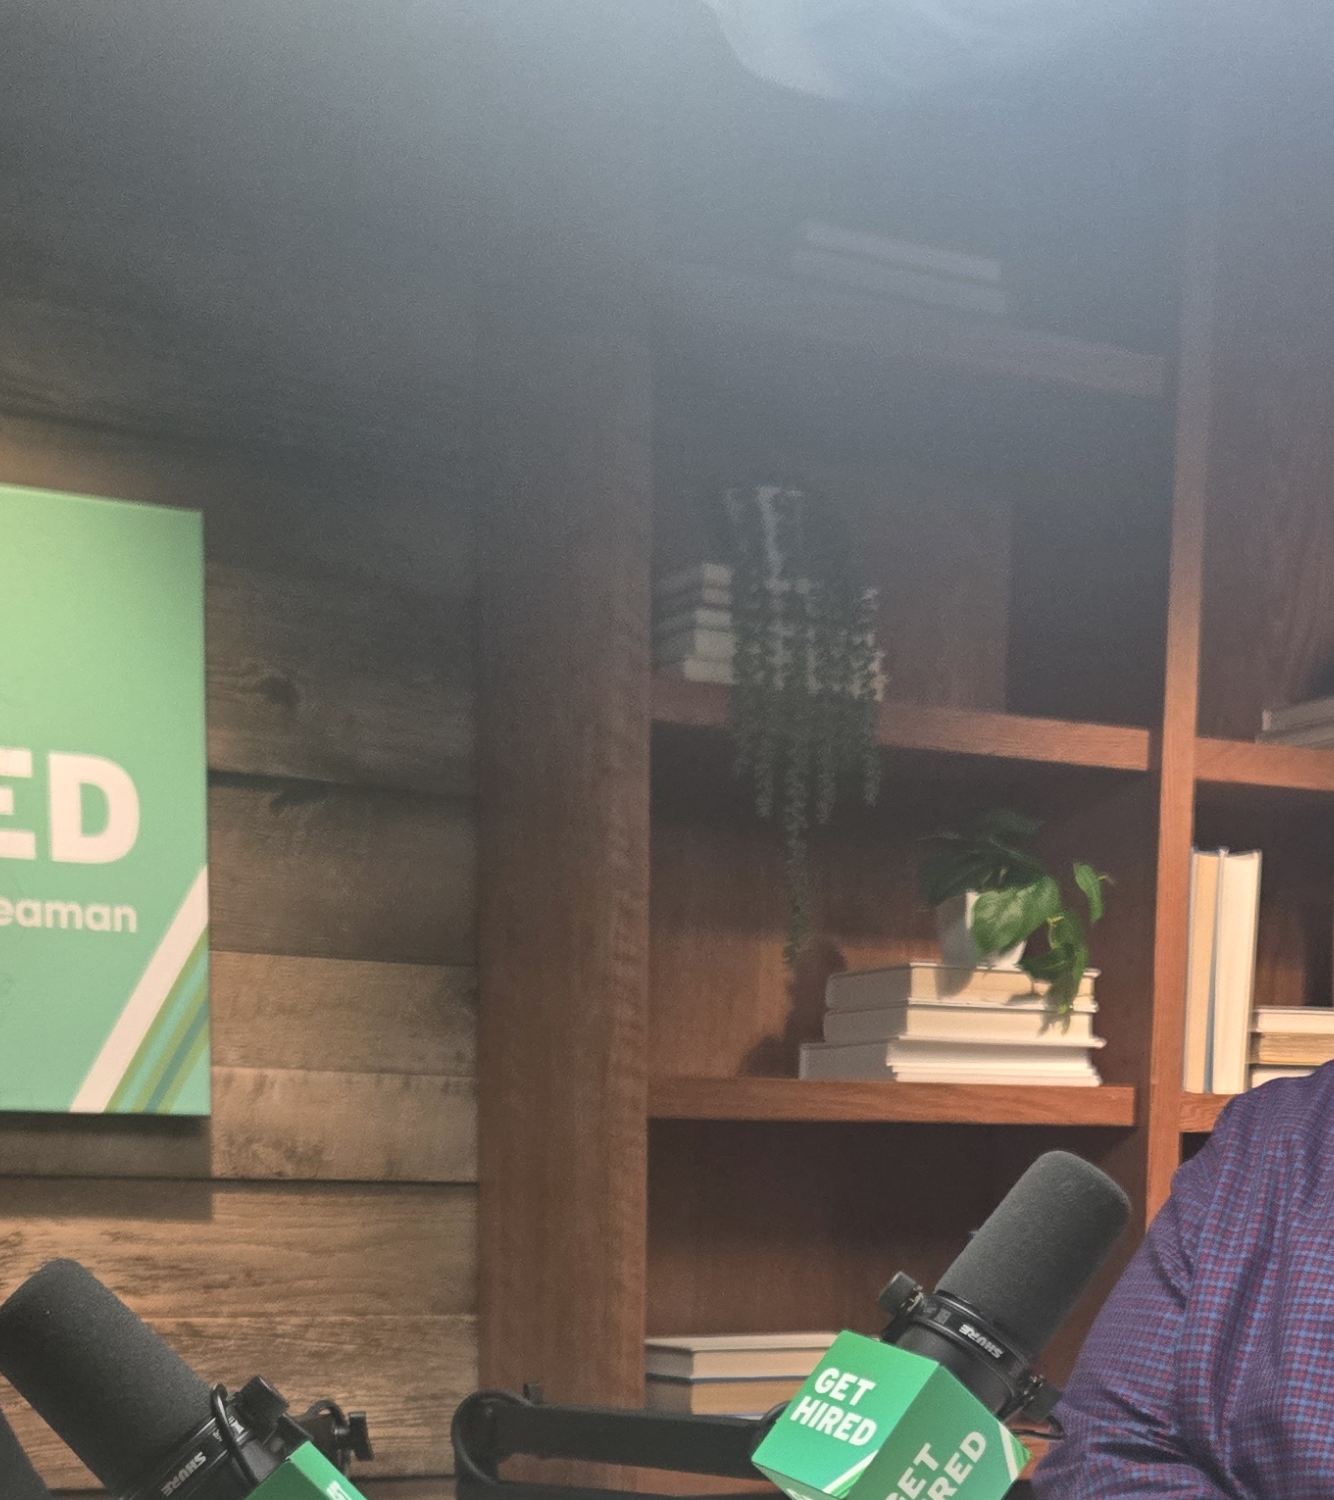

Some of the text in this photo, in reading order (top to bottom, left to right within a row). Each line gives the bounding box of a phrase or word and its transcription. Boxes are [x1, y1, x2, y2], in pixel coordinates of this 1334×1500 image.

[958, 1323, 1004, 1359] SHURE
[814, 1367, 876, 1406] GET
[790, 1395, 878, 1447] HIRED
[160, 1451, 207, 1497] SHURE
